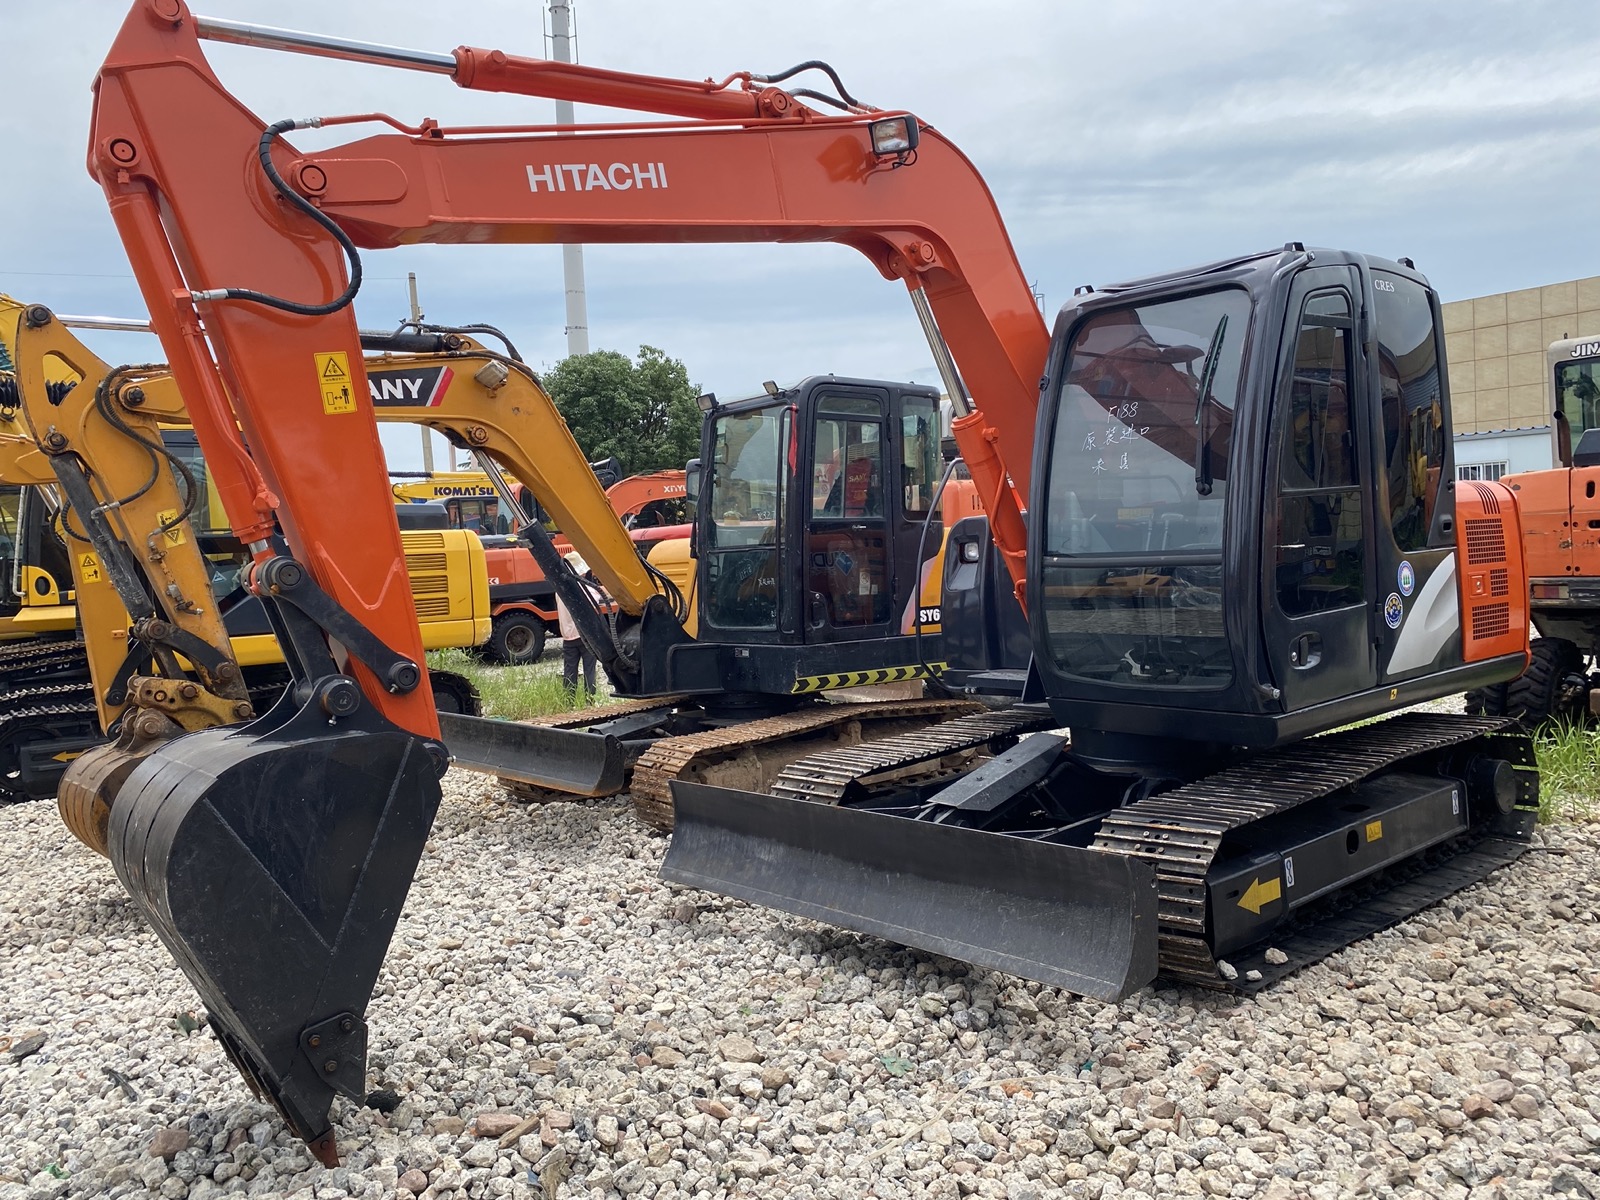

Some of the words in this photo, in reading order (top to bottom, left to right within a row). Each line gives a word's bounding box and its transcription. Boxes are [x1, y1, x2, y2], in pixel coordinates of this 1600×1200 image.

[525, 162, 668, 193] HITACHI
[1374, 279, 1395, 293] CRES
[1107, 401, 1139, 424] F188
[433, 484, 495, 496] KOMATSU
[919, 608, 941, 622] SY6
